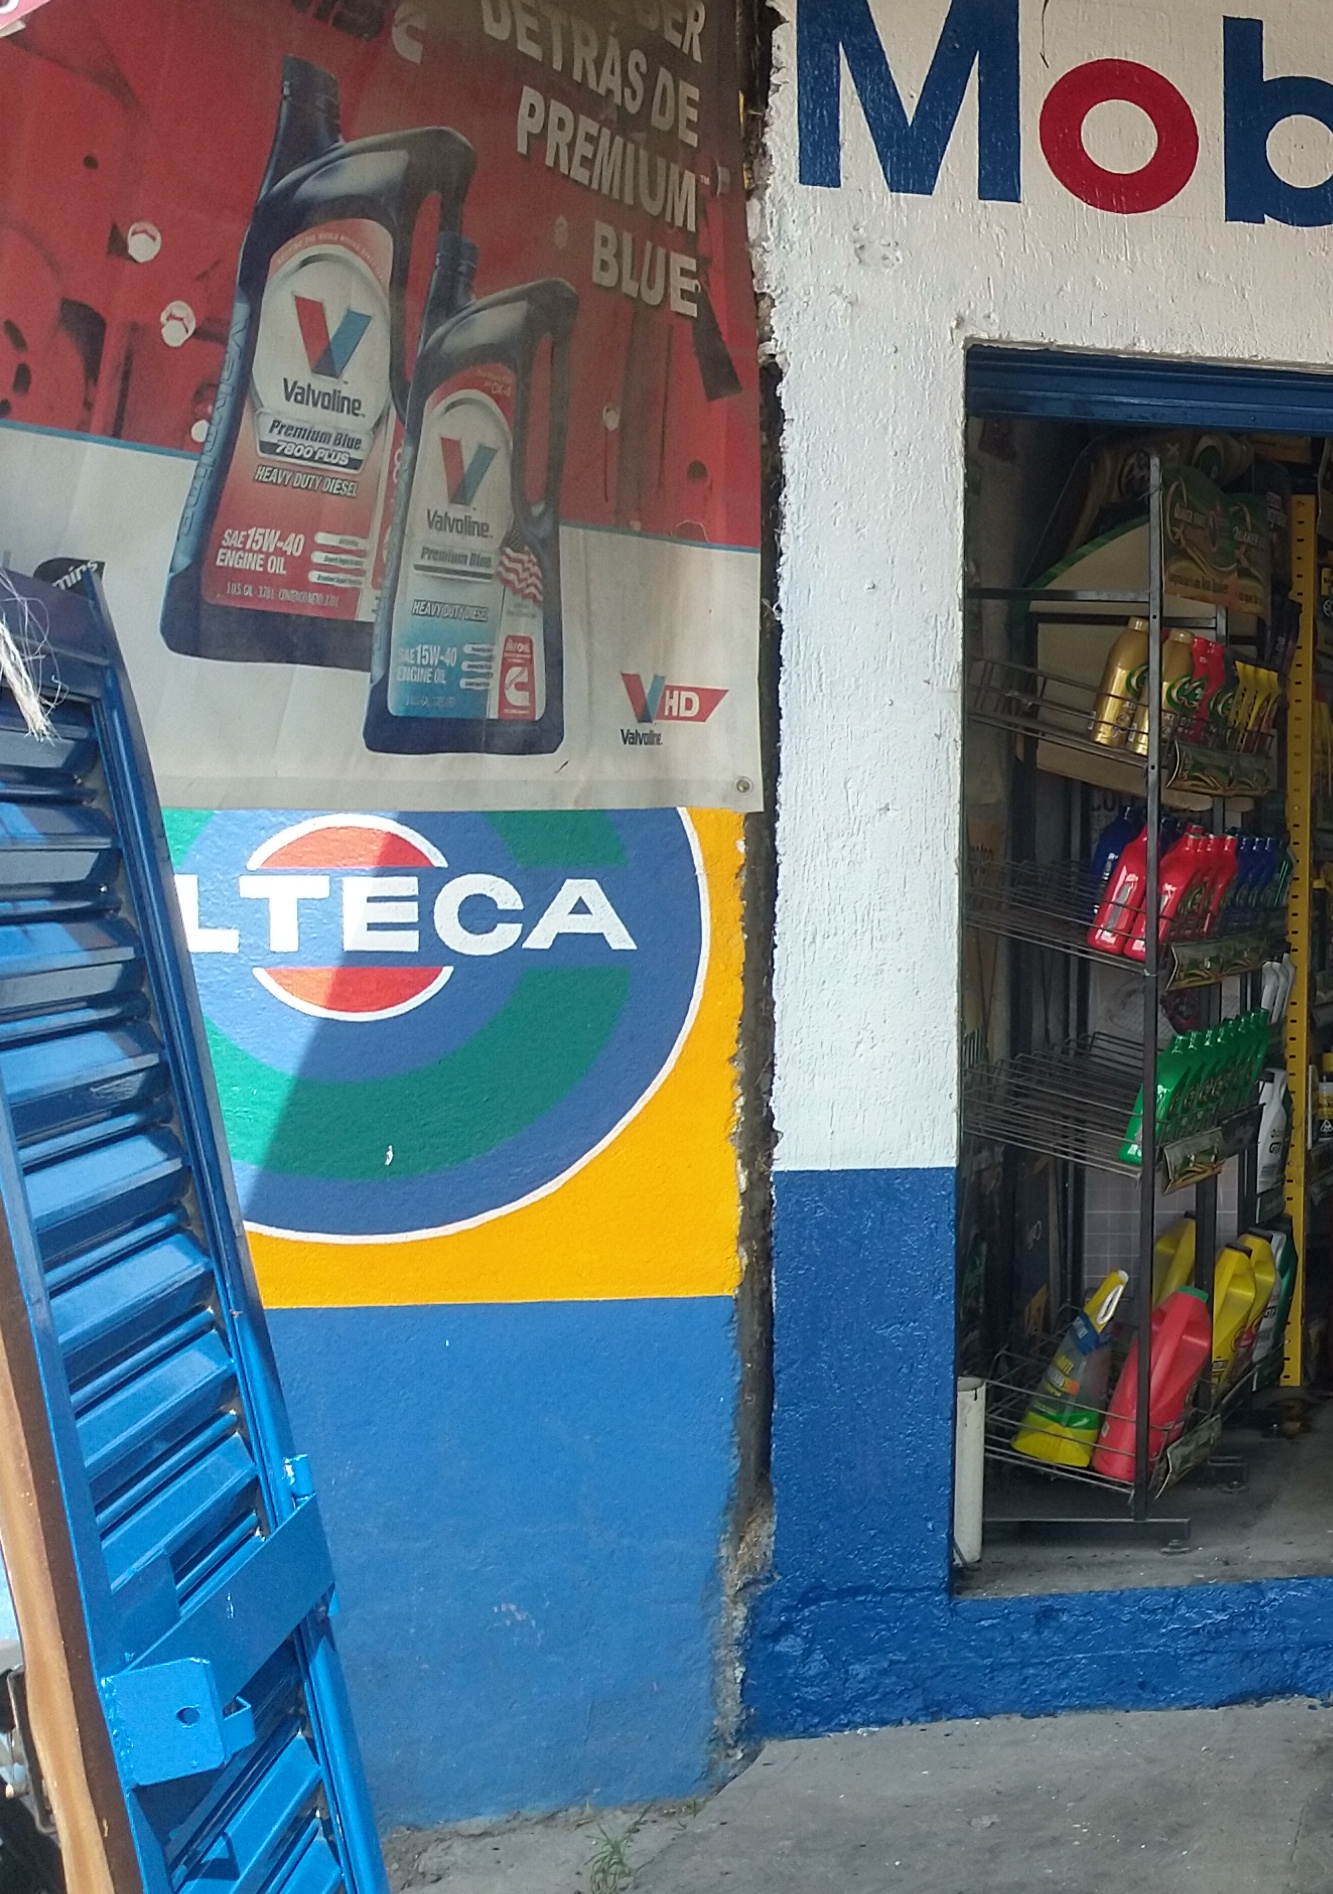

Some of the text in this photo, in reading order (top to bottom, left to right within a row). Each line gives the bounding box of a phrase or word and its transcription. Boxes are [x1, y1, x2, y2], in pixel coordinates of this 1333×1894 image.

[652, 67, 699, 148] DE
[517, 86, 696, 232] PREMIUM
[592, 220, 698, 318] BLUE
[283, 378, 362, 417] Valvoline
[269, 420, 362, 450] Premium Blue
[276, 440, 349, 466] 7800 PLUS
[255, 465, 357, 496] HEAVY DUTY DIESEL
[427, 508, 491, 539] Valvoline
[222, 527, 304, 557] SAE 15W-40
[216, 550, 286, 574] ENGINE OIL
[412, 600, 440, 615] HEAVY
[415, 644, 457, 667] 15W-40
[664, 690, 700, 718] HD
[620, 727, 662, 746] Valvoline
